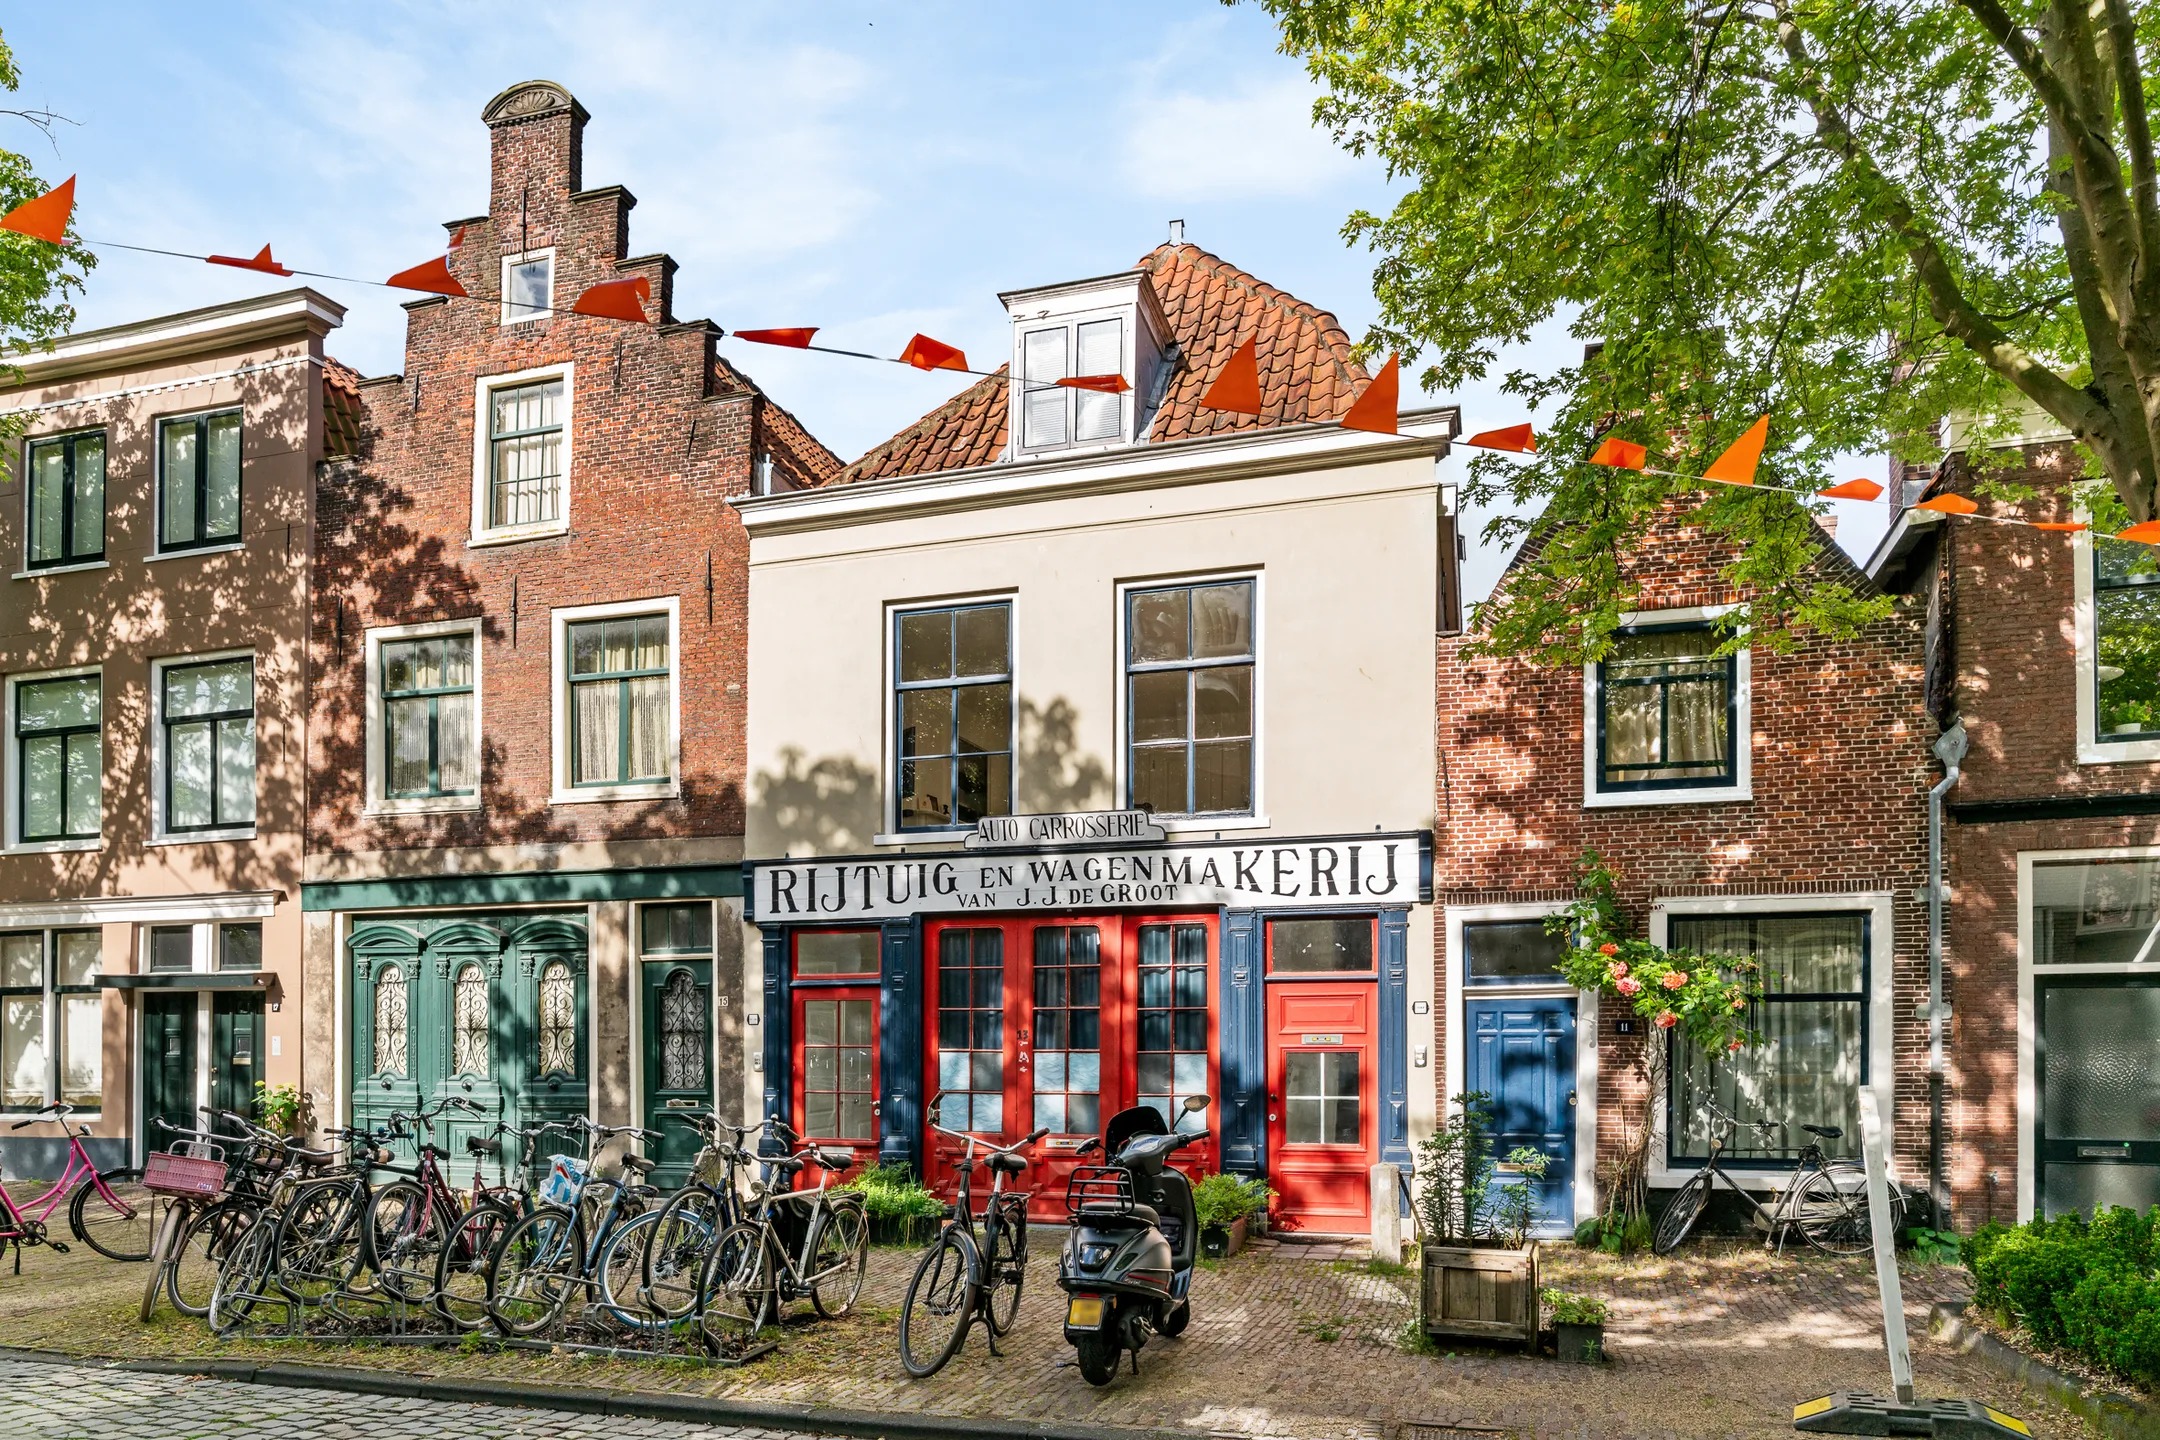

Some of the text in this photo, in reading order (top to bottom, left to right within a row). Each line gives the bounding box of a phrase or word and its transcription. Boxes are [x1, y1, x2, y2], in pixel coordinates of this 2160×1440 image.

[978, 813, 1145, 843] AUTO CARROSSERIE
[769, 844, 1399, 914] RIJTUIG EN WAGENMAKERIJ
[956, 893, 996, 908] VAN
[1068, 888, 1093, 906] DE
[1100, 884, 1178, 904] GROOT
[719, 997, 728, 1006] 15
[1017, 1030, 1029, 1040] 13
[1620, 1022, 1629, 1032] 11
